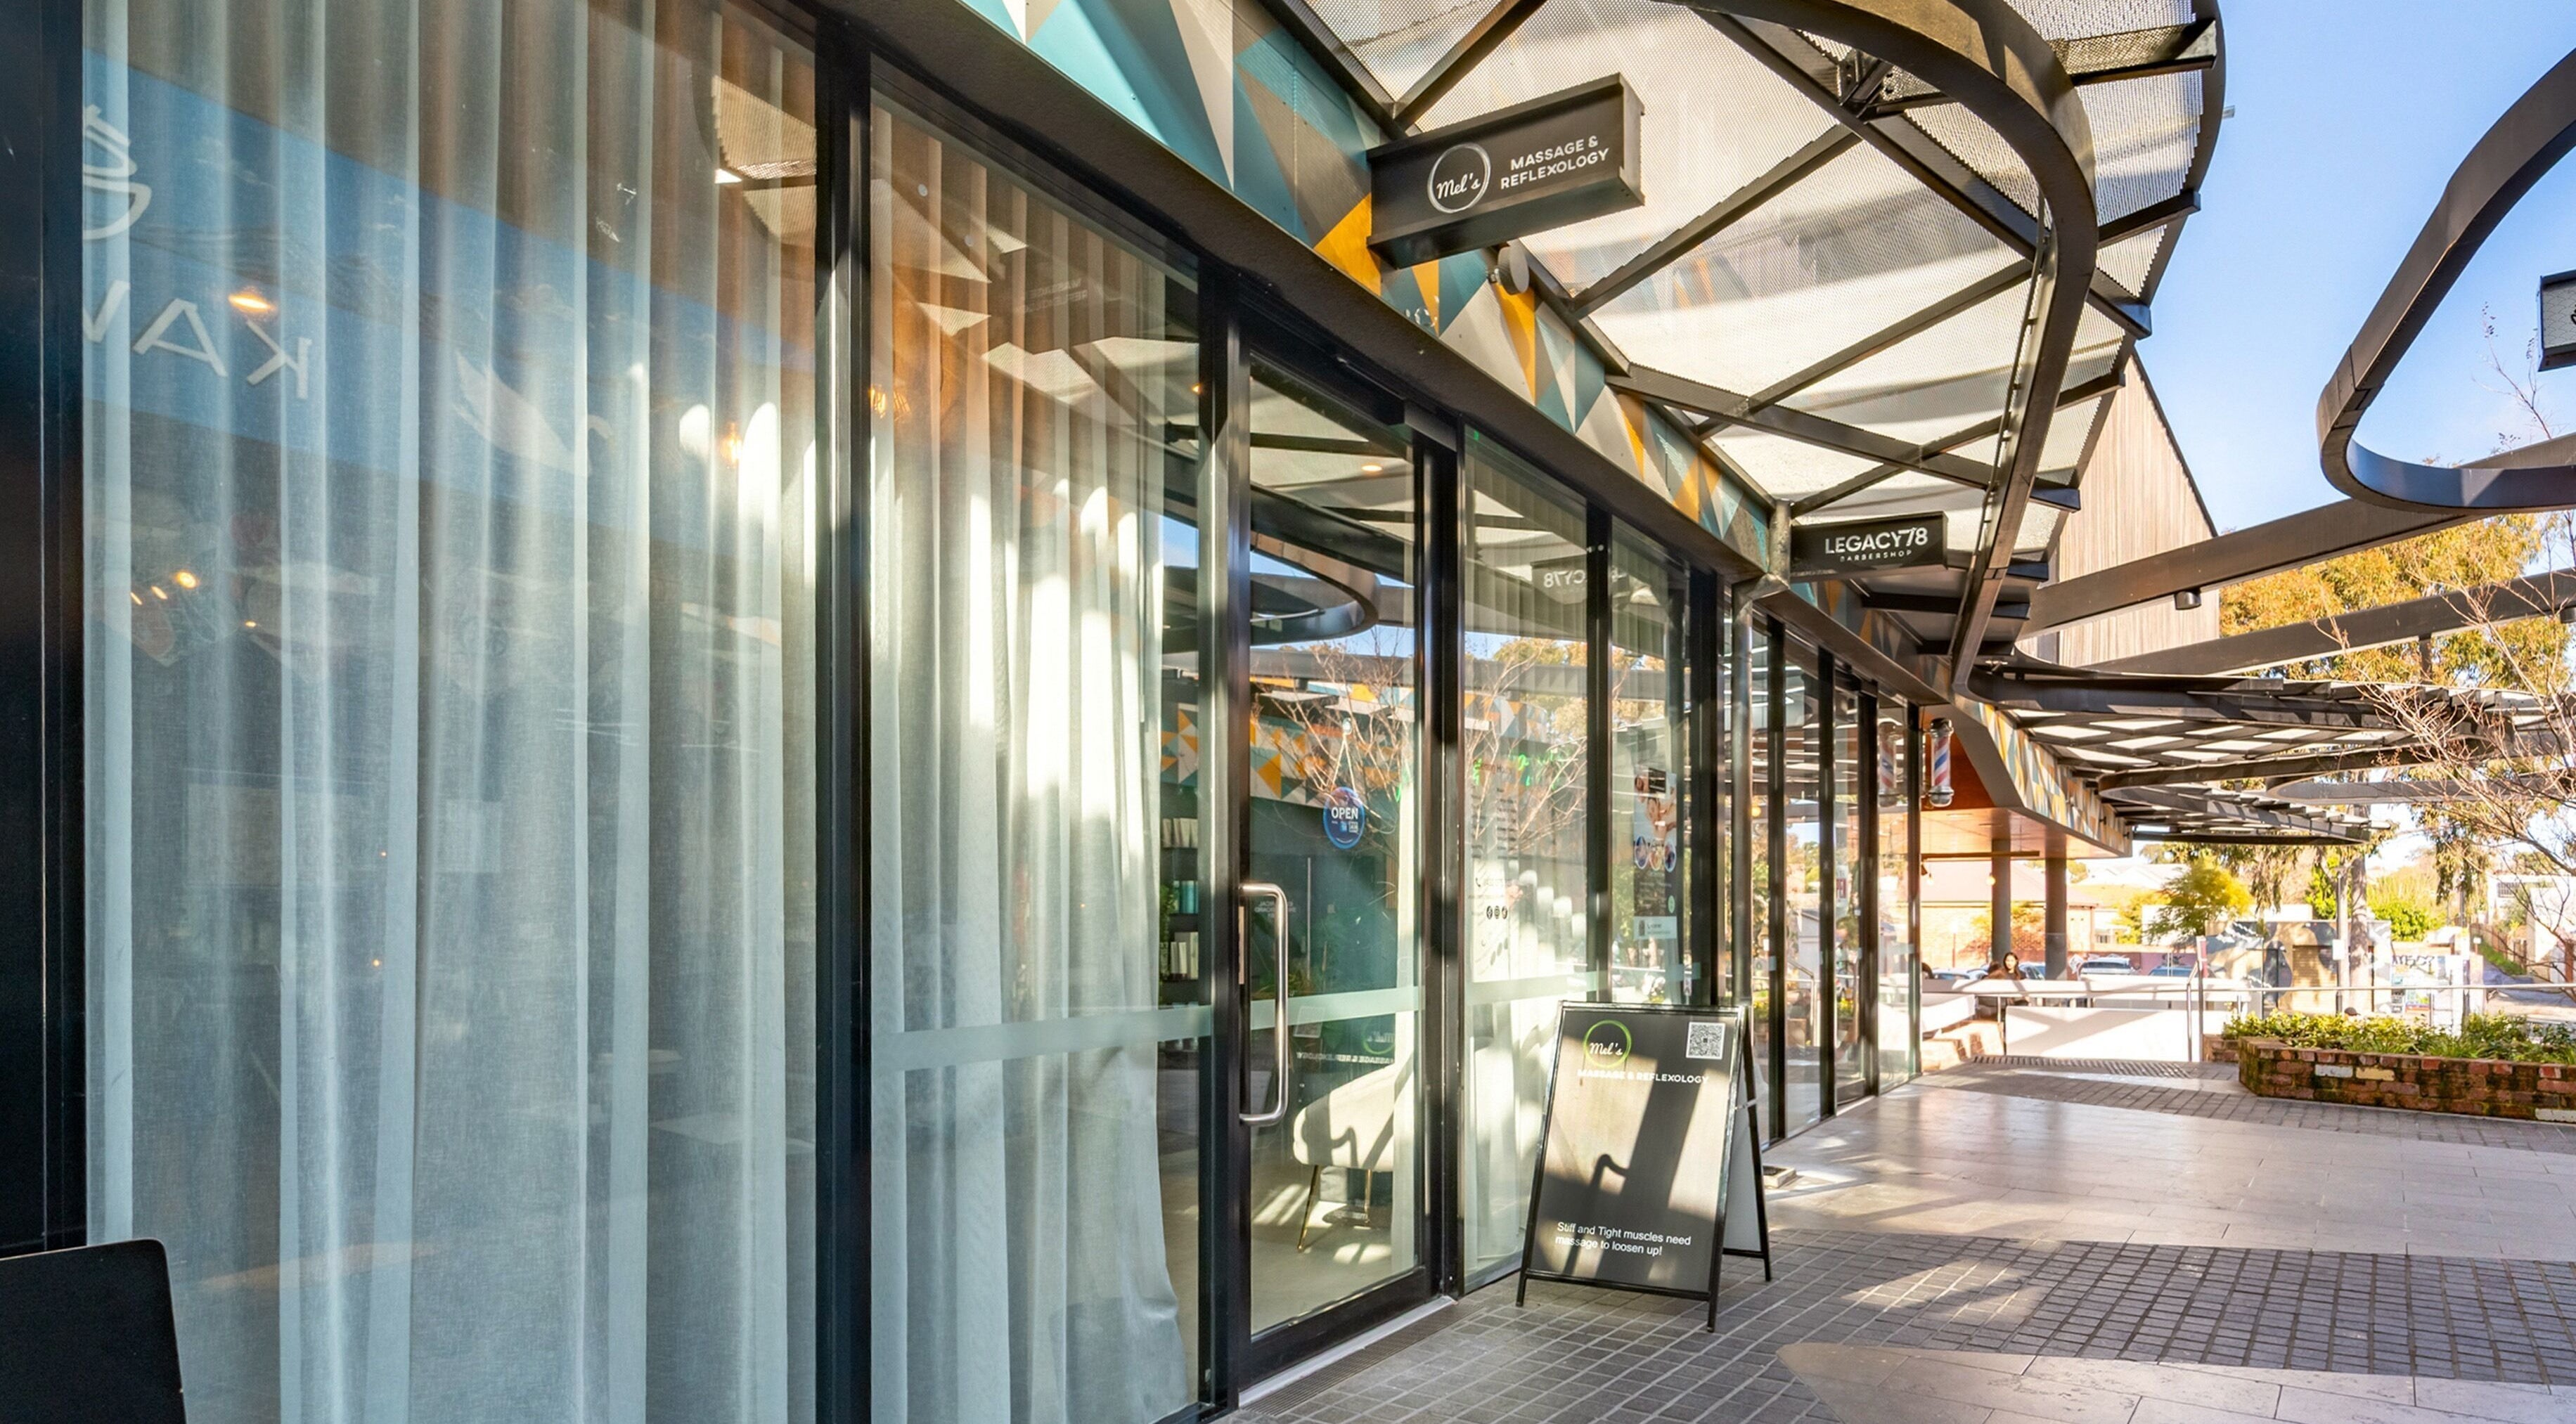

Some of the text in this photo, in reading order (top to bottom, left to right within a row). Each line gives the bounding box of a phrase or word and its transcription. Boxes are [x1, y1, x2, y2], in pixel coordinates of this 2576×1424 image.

[1510, 135, 1599, 171] MASSAGE &
[1500, 148, 1609, 190] REFLEXOLOGY
[1436, 172, 1481, 200] Mel's
[1825, 526, 1928, 554] LEGACY78
[1840, 549, 1912, 562] BARBERSHOP
[1331, 806, 1359, 820] OPEN
[1590, 1042, 1623, 1056] Mel's
[1577, 1068, 1626, 1080] MASSAGE
[1636, 1072, 1710, 1084] REFLEXOLOGY
[1557, 1222, 1692, 1245] Stiff and Tight muscles need
[1555, 1236, 1663, 1257] massage to loosen up!
